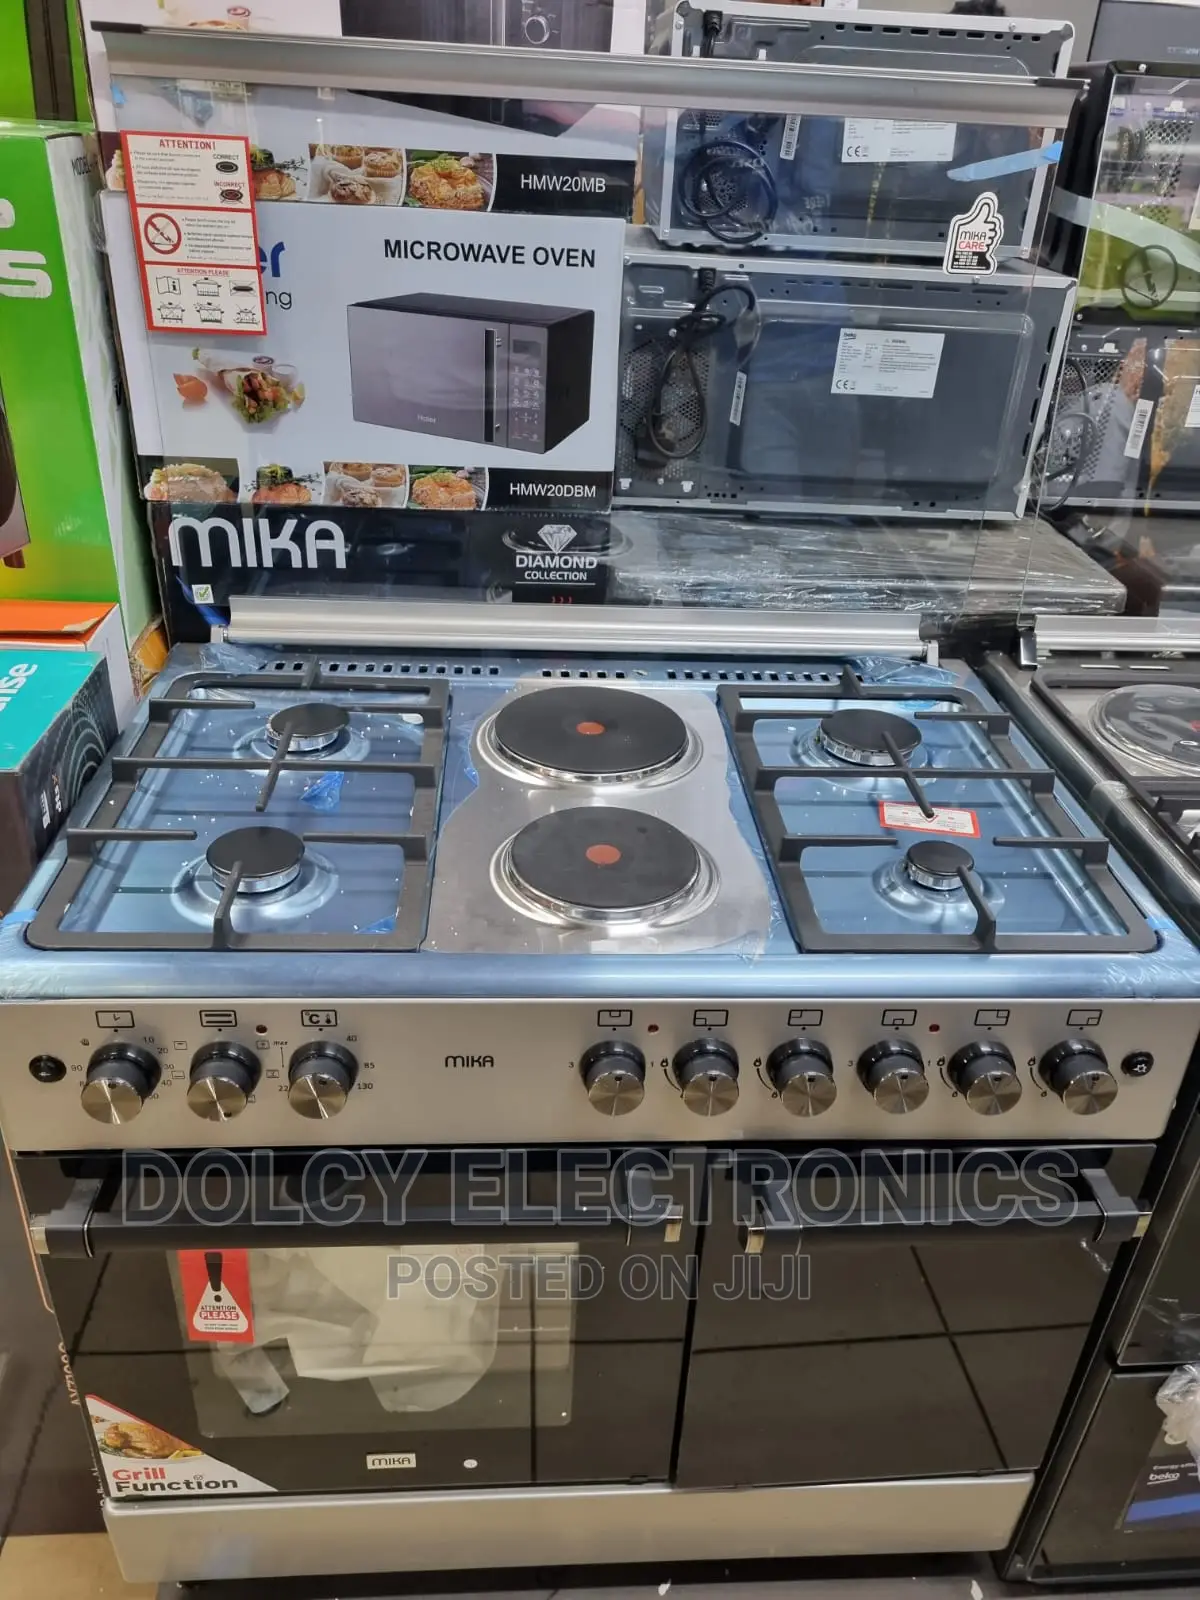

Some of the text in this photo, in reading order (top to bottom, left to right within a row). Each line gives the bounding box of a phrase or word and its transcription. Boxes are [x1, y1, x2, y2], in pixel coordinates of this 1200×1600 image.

[159, 138, 216, 151] ATTENTION!
[520, 173, 606, 193] HMW20MB
[960, 231, 987, 240] MIKA
[958, 241, 985, 250] CARE
[384, 239, 596, 268] MICROWAVE OVEN
[509, 482, 597, 498] HMW20DBM
[168, 517, 347, 569] MIKA
[515, 555, 598, 569] DIAMOND
[524, 571, 588, 580] COLLECTION
[444, 1055, 495, 1069] MIKA
[201, 1312, 238, 1320] PLEASE
[372, 1457, 411, 1466] MIKA
[112, 1467, 167, 1481] Grill
[115, 1478, 239, 1493] Function
